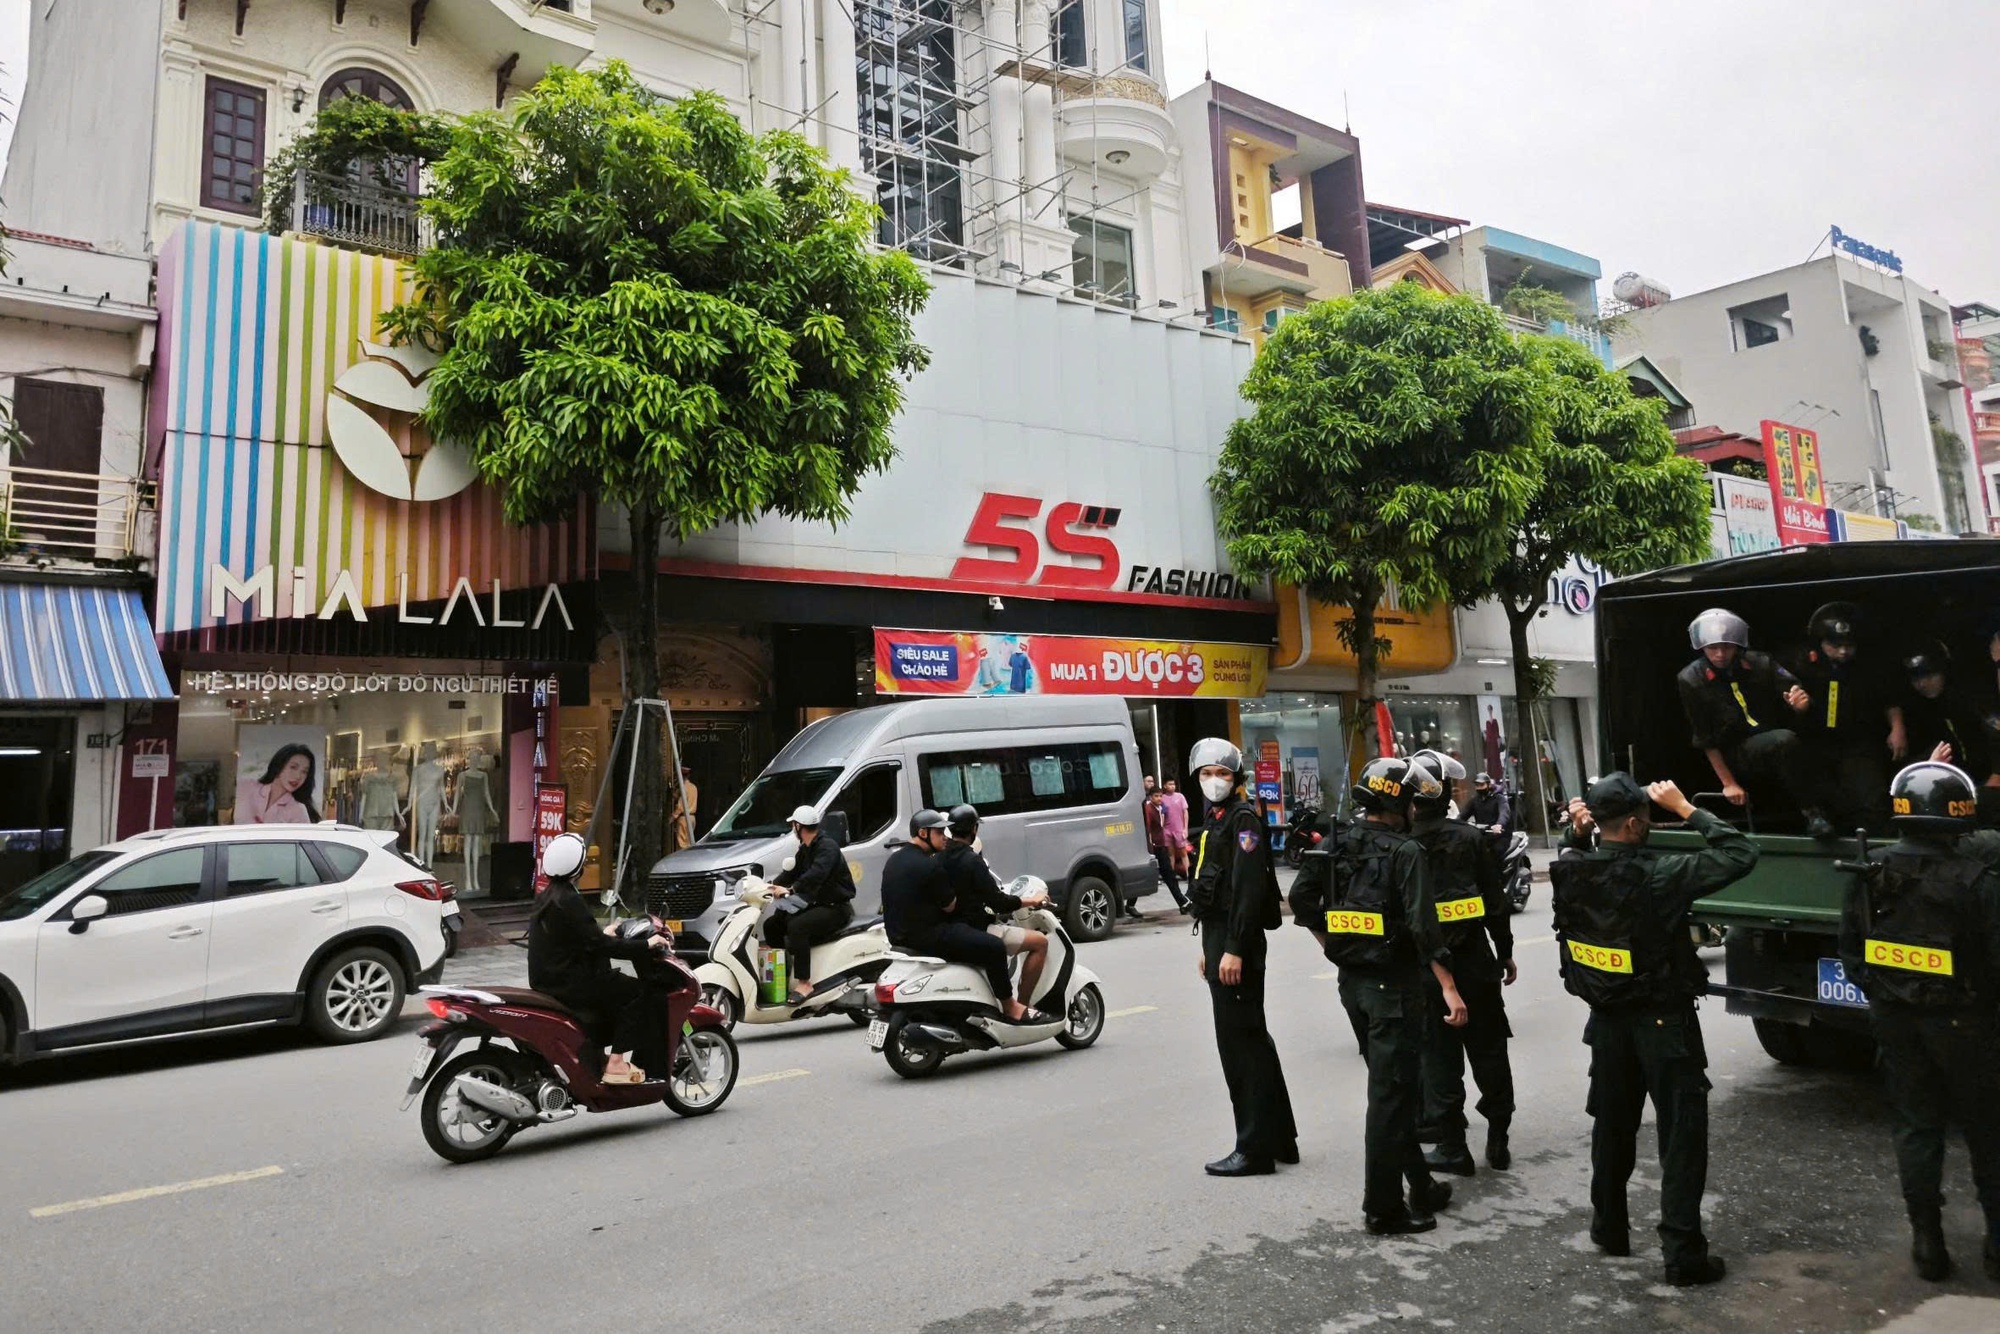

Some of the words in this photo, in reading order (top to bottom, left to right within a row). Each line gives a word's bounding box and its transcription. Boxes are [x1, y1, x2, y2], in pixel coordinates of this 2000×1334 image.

[398, 572, 575, 631] LALA
[896, 646, 921, 661] SIÊU
[921, 650, 949, 661] SALE
[1213, 657, 1230, 670] SẢN
[901, 662, 932, 676] CHÀO
[932, 664, 948, 676] HÈ
[1050, 662, 1088, 681] MUA
[1088, 663, 1097, 681] 1
[1102, 650, 1184, 689] ĐƯỢC
[1186, 653, 1205, 684] 3
[194, 669, 226, 694] HỆ
[232, 666, 310, 691] THỐNG
[315, 667, 346, 691] ĐỒ
[353, 671, 392, 692] LÓT
[398, 669, 427, 692] ĐỒ
[432, 672, 474, 693] NGỦ
[479, 671, 530, 694] THIẾT
[533, 672, 559, 694] KẾ
[135, 738, 169, 756] 171
[540, 811, 563, 831] 59K
[1330, 914, 1376, 931] CSCĐ
[1573, 945, 1624, 968] CSCĐ
[1874, 945, 1942, 969] CSCĐ
